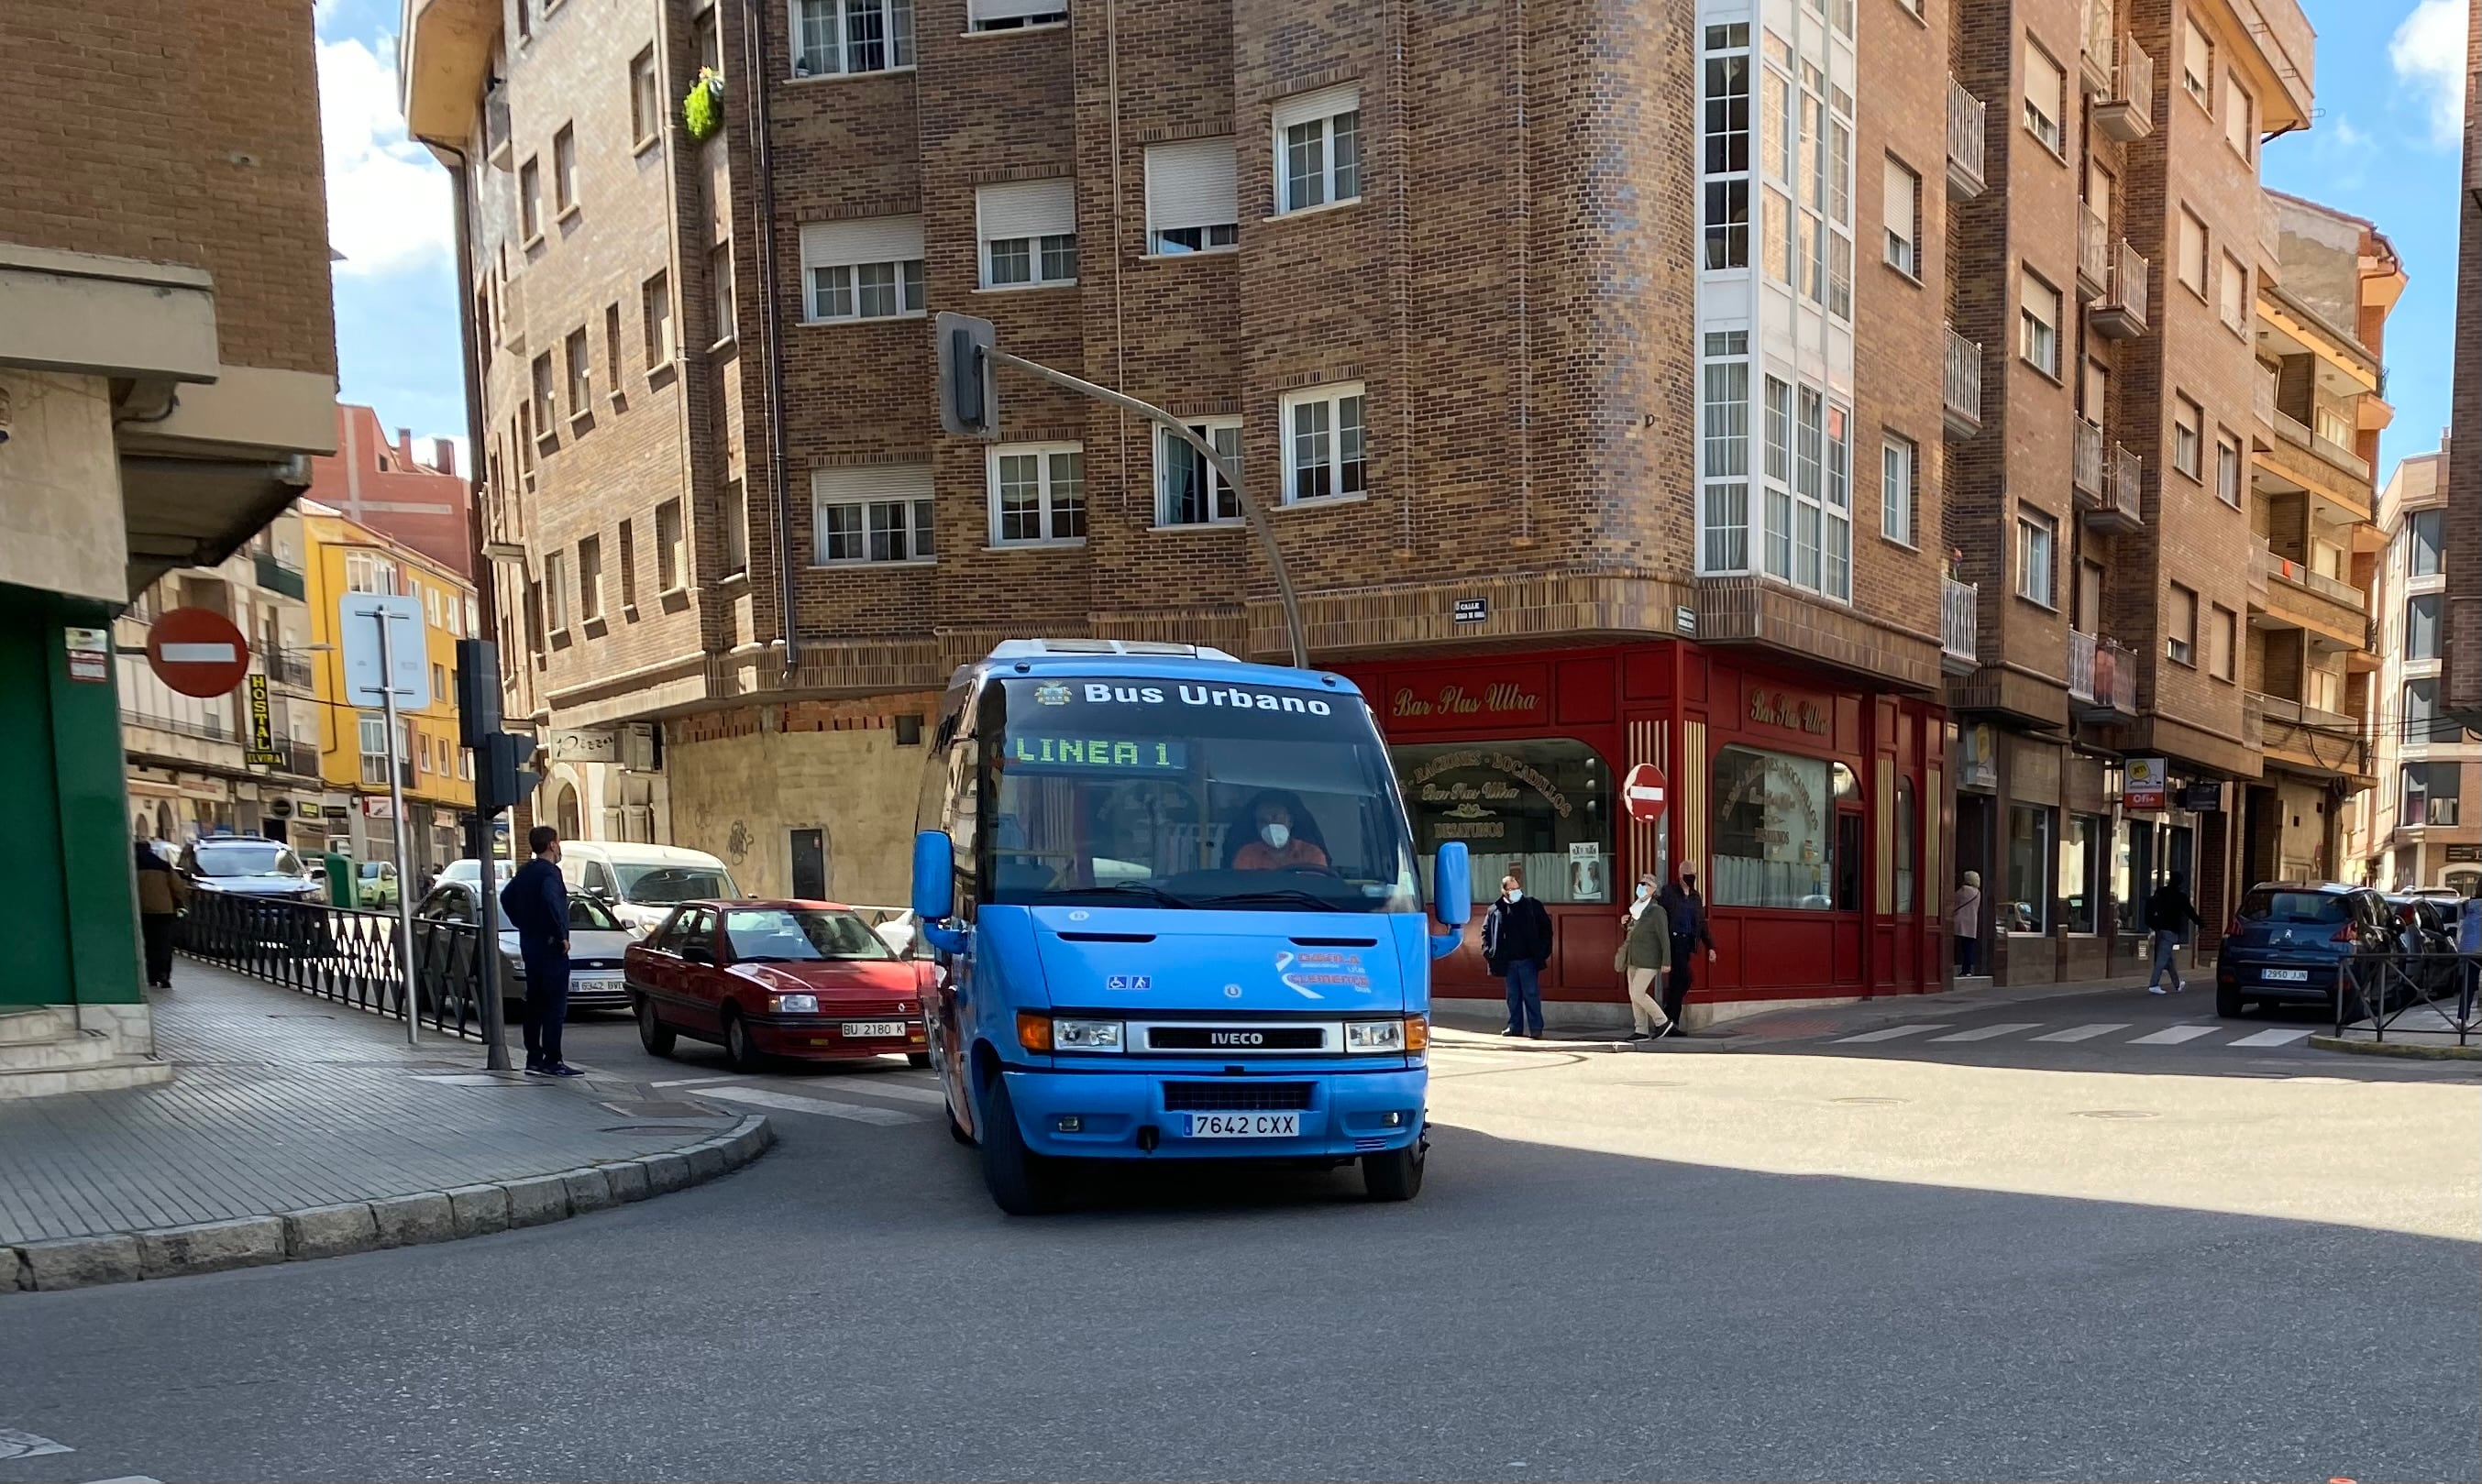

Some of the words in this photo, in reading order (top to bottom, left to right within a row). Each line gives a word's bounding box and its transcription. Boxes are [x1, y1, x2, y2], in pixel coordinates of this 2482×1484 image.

[1460, 602, 1480, 610] CALLE
[1084, 684, 1164, 704] Bus
[1179, 685, 1330, 717] Urbano
[1393, 687, 1433, 717] Bar
[1437, 685, 1482, 715] Plus
[1484, 683, 1540, 712] Ultra
[251, 676, 270, 751] HOSTAL
[1016, 738, 1138, 765] LINEA
[1155, 742, 1171, 766] 1
[1413, 750, 1482, 785] RACIONES
[1492, 752, 1573, 819] BOCADILLOS
[1433, 821, 1505, 839] DESAYUNOS
[864, 1024, 891, 1035] 2180
[897, 1024, 903, 1034] K
[1211, 1032, 1263, 1045] IVECO
[1197, 1116, 1249, 1134] 7642
[1256, 1116, 1294, 1134] CXX
